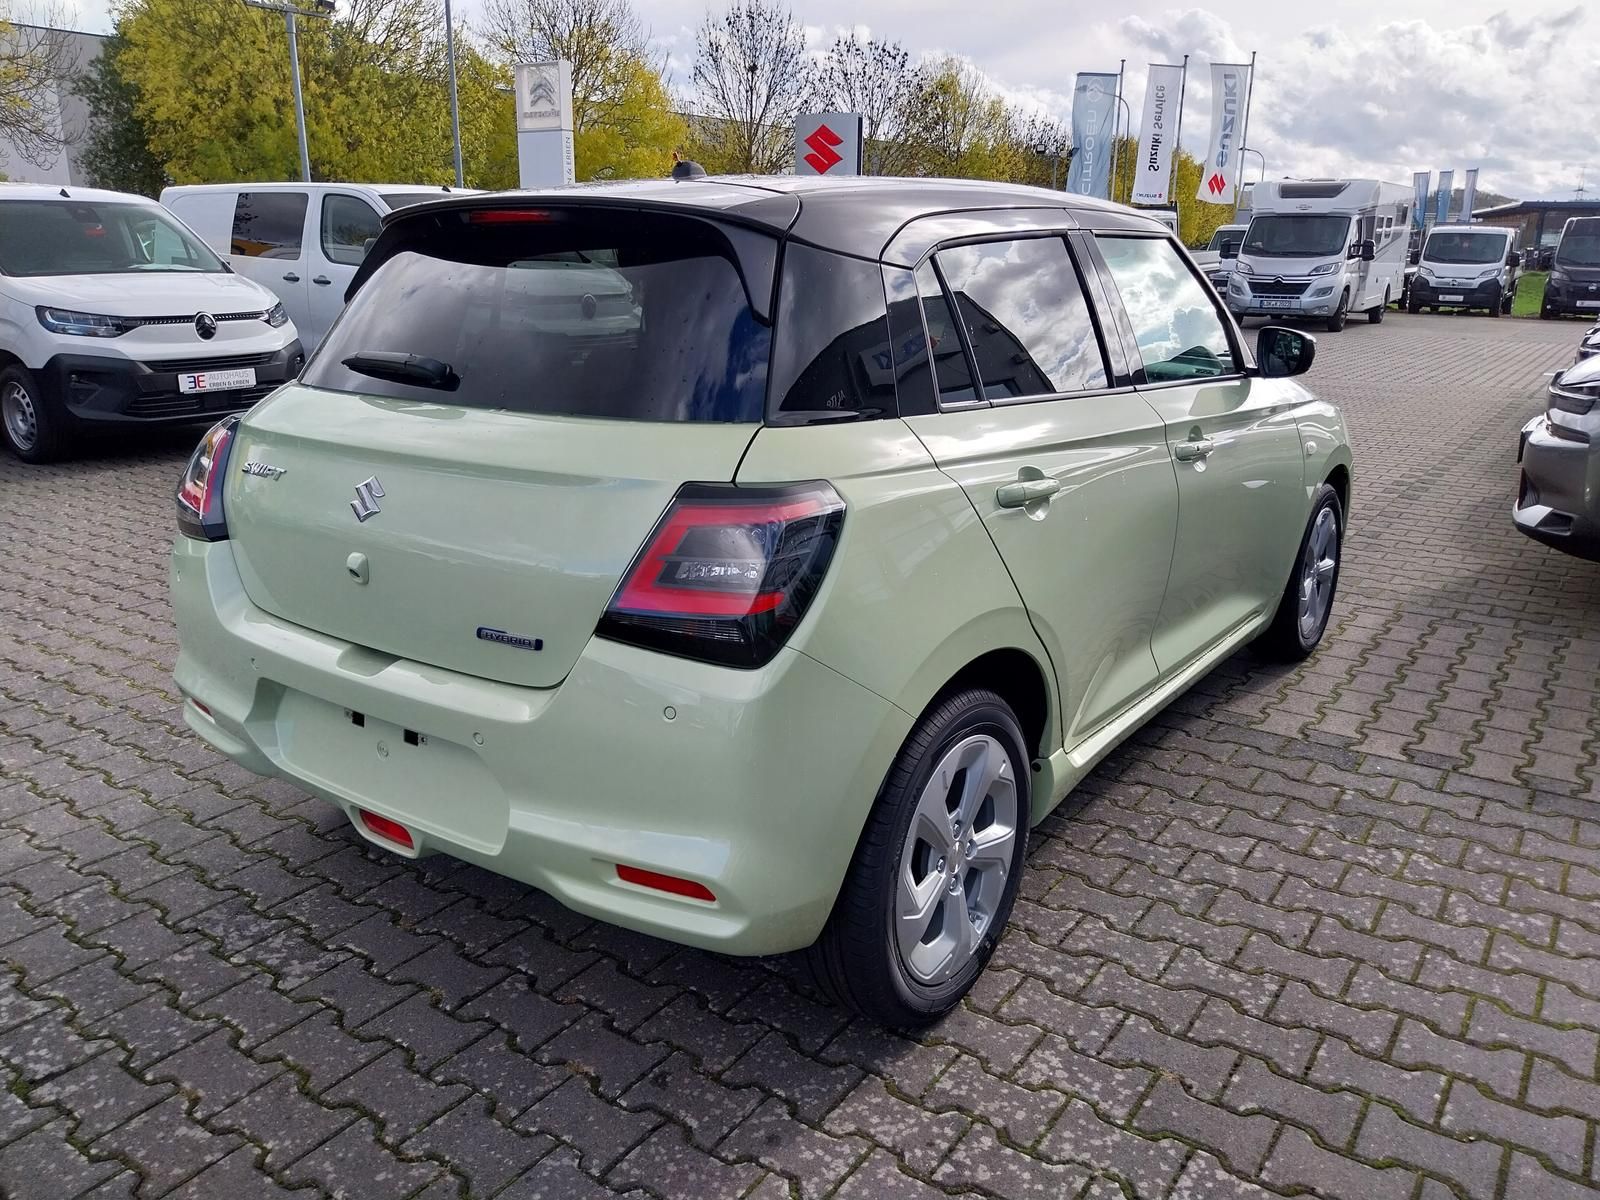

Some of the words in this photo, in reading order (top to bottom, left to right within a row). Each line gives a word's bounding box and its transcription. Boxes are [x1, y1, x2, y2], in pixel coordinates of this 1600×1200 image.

[208, 370, 249, 381] AUTOHAUS
[242, 461, 287, 481] SWIFT
[484, 631, 532, 648] HYBRID
